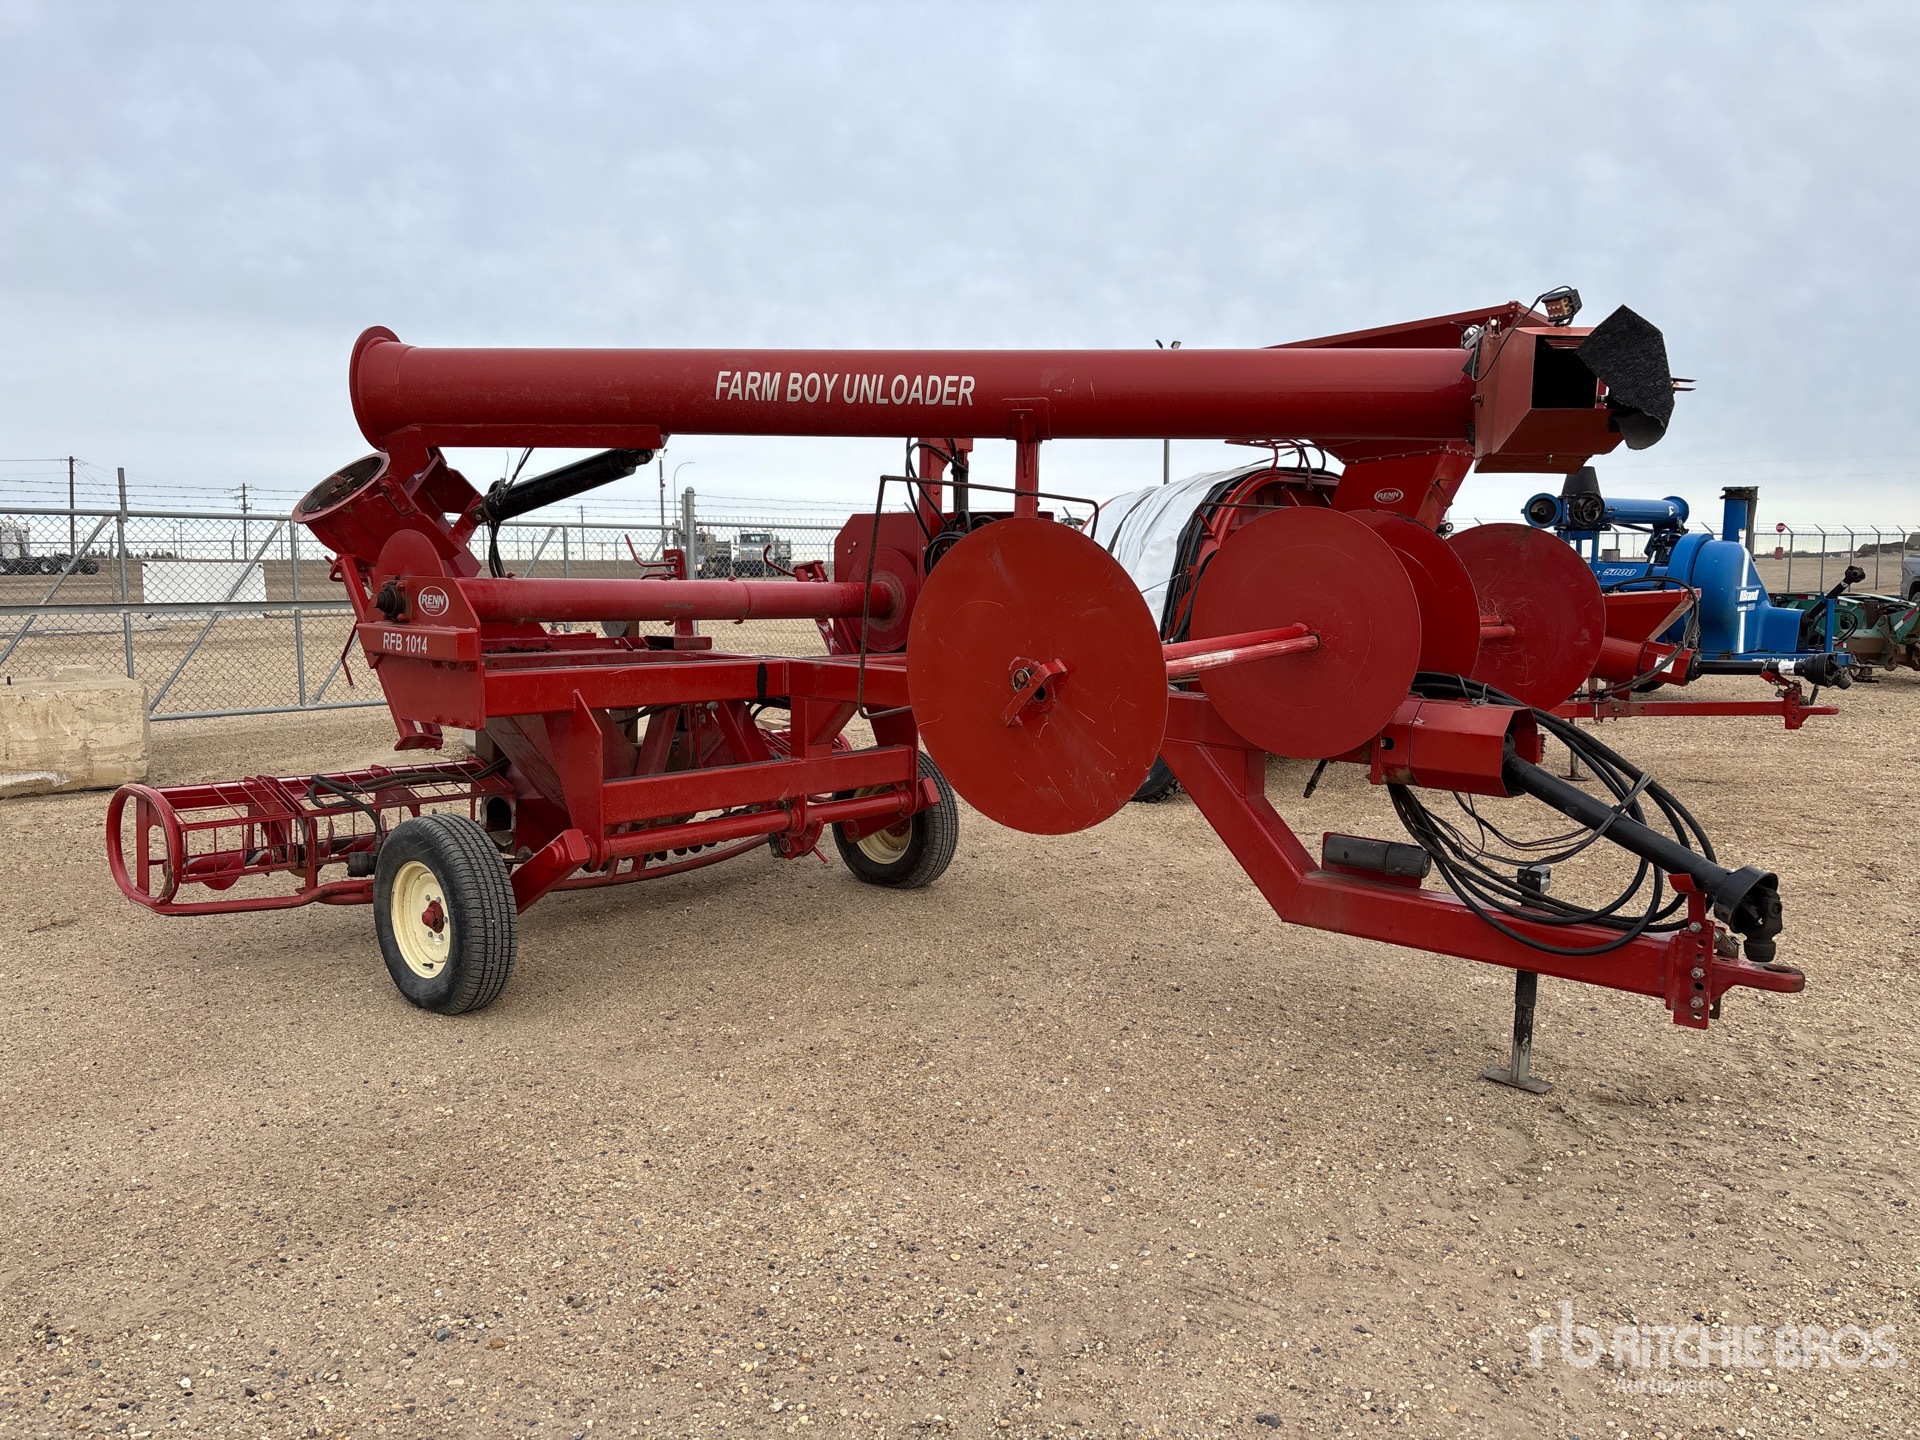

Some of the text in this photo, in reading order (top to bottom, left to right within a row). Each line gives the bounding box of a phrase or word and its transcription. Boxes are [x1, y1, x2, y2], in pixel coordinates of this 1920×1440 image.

[715, 371, 976, 406] FARM BOY UNLOADER
[1377, 491, 1400, 499] RENN
[421, 594, 445, 606] RENN
[383, 632, 428, 654] RFB 1014
